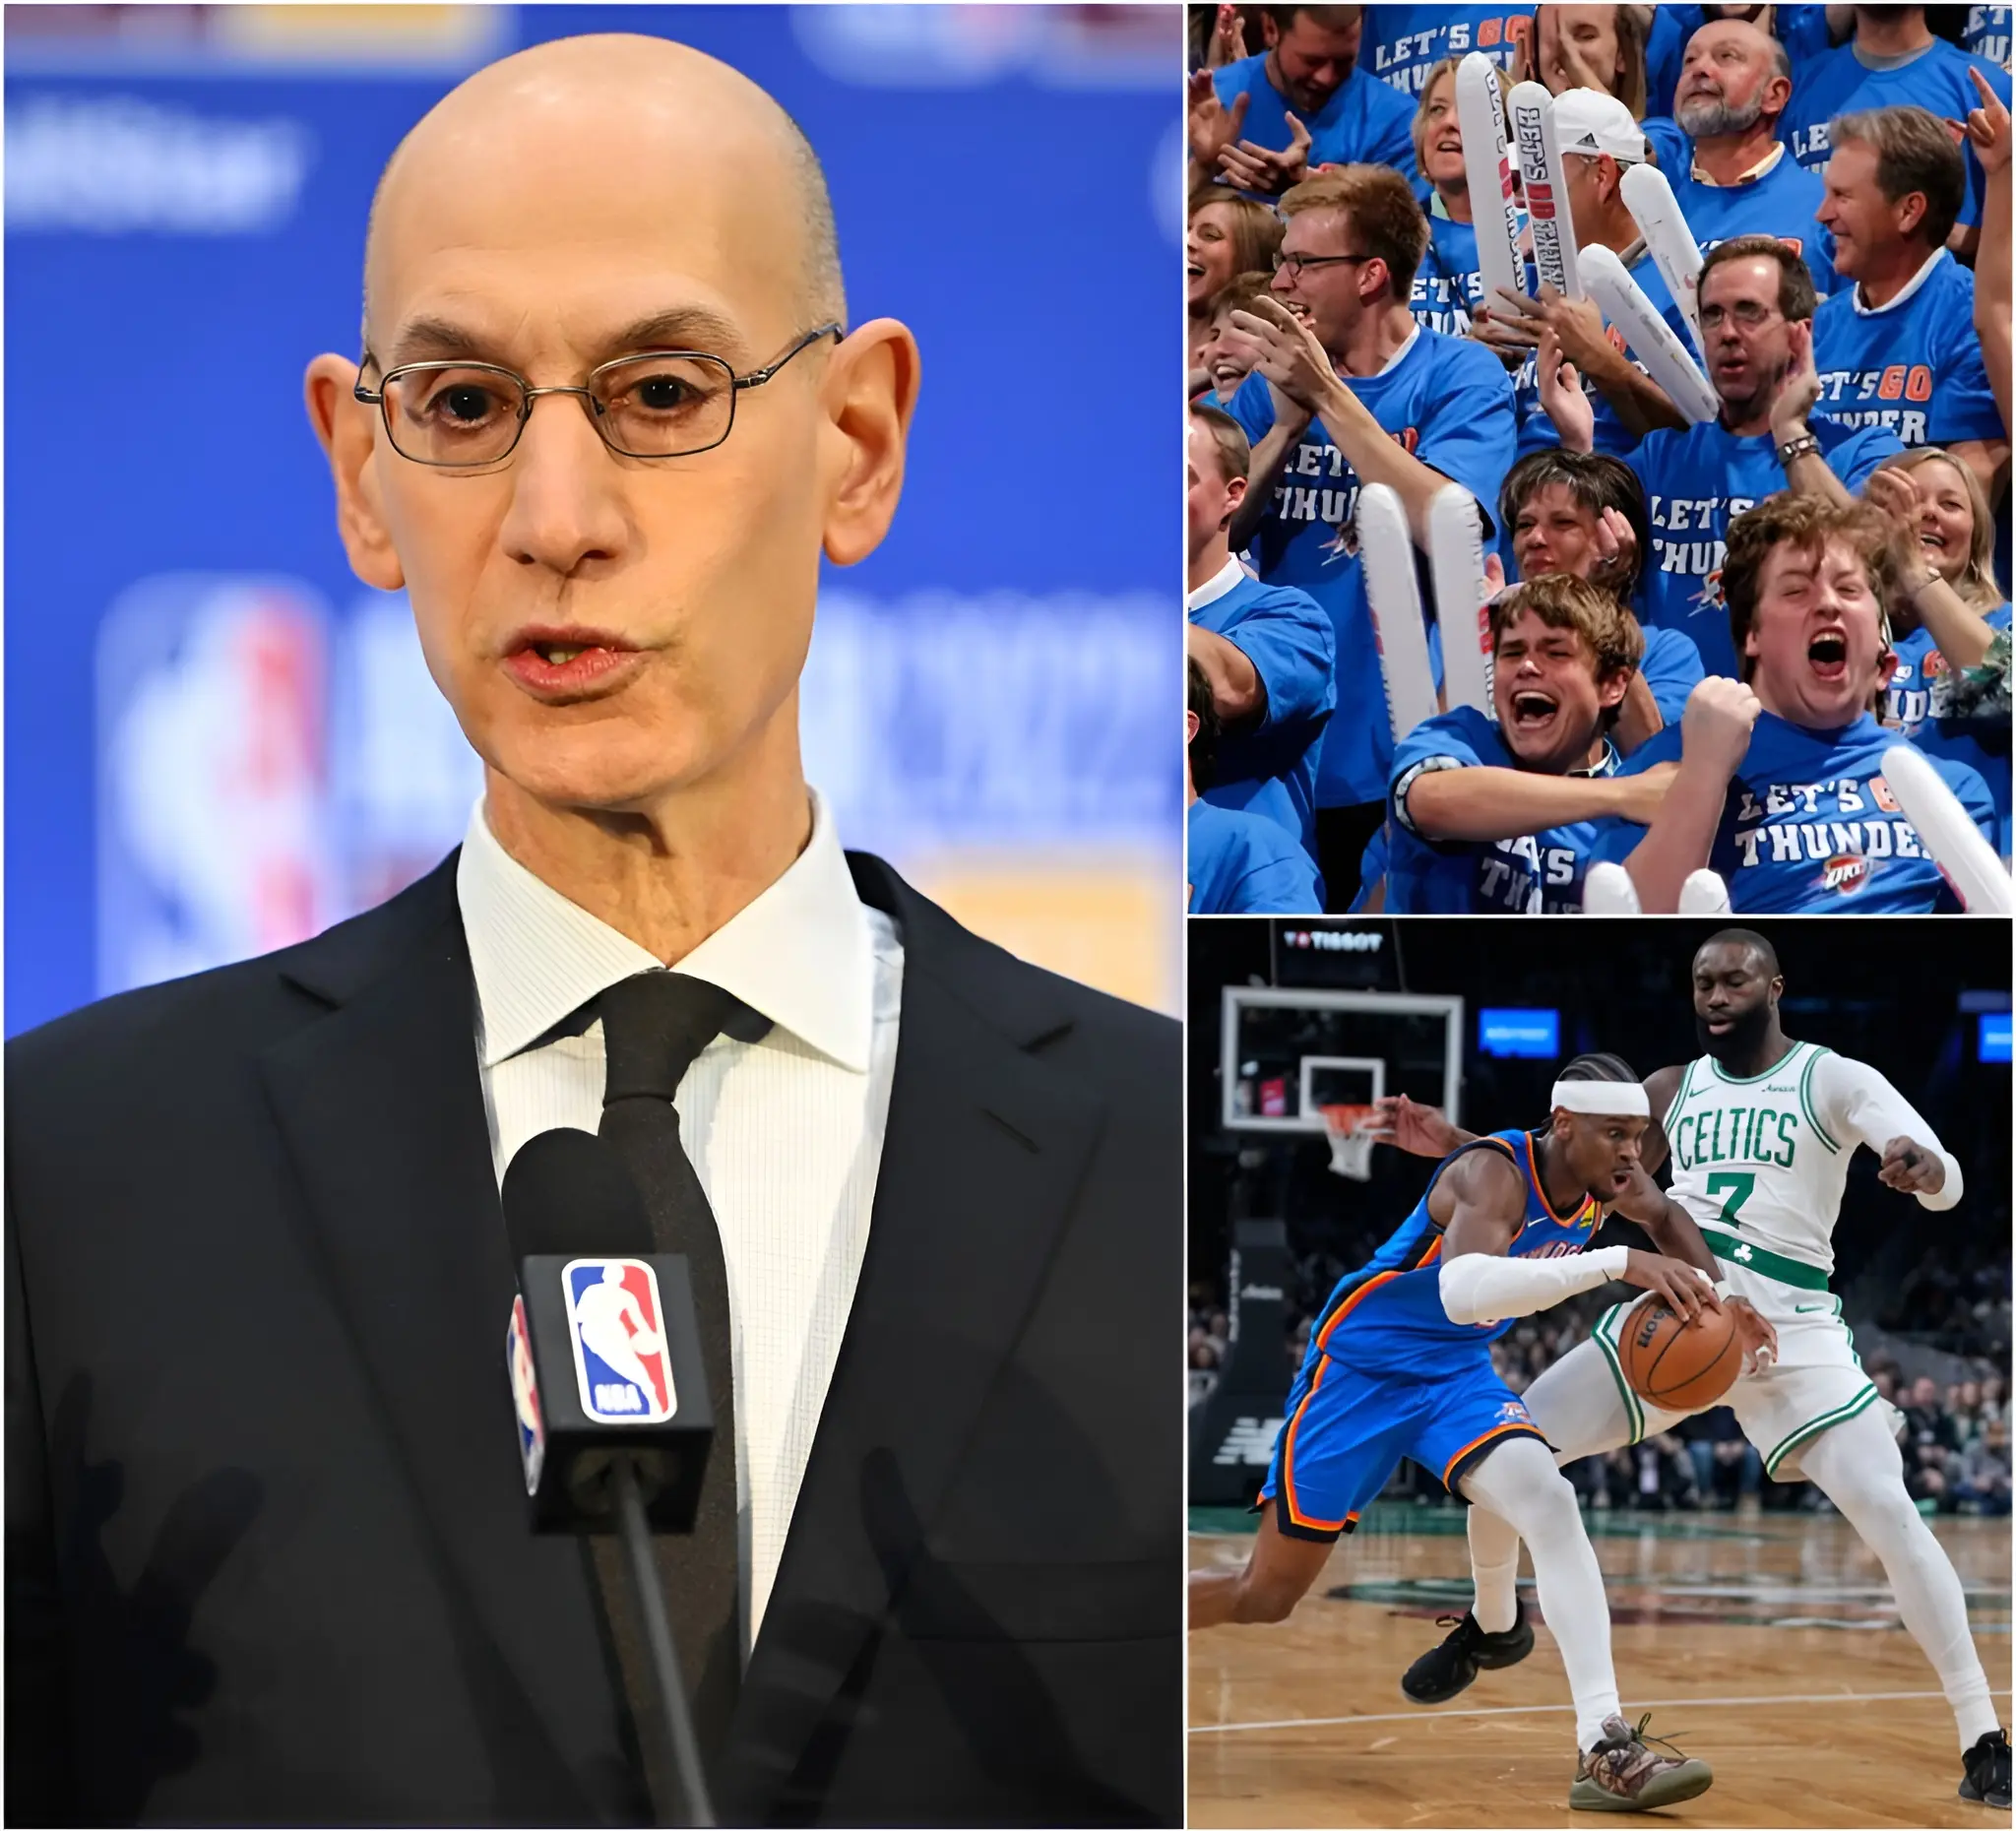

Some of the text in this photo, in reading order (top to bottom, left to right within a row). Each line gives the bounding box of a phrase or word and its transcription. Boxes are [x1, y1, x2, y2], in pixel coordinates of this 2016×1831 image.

[1376, 23, 1470, 71] LET'S
[1410, 272, 1483, 303] ET'S
[1816, 365, 1932, 402] ET'S GO
[1737, 779, 1864, 821] LET'S
[1734, 820, 1932, 867] THUNDE
[1677, 1107, 1798, 1170] CELTICS
[1706, 1171, 1756, 1231] 7
